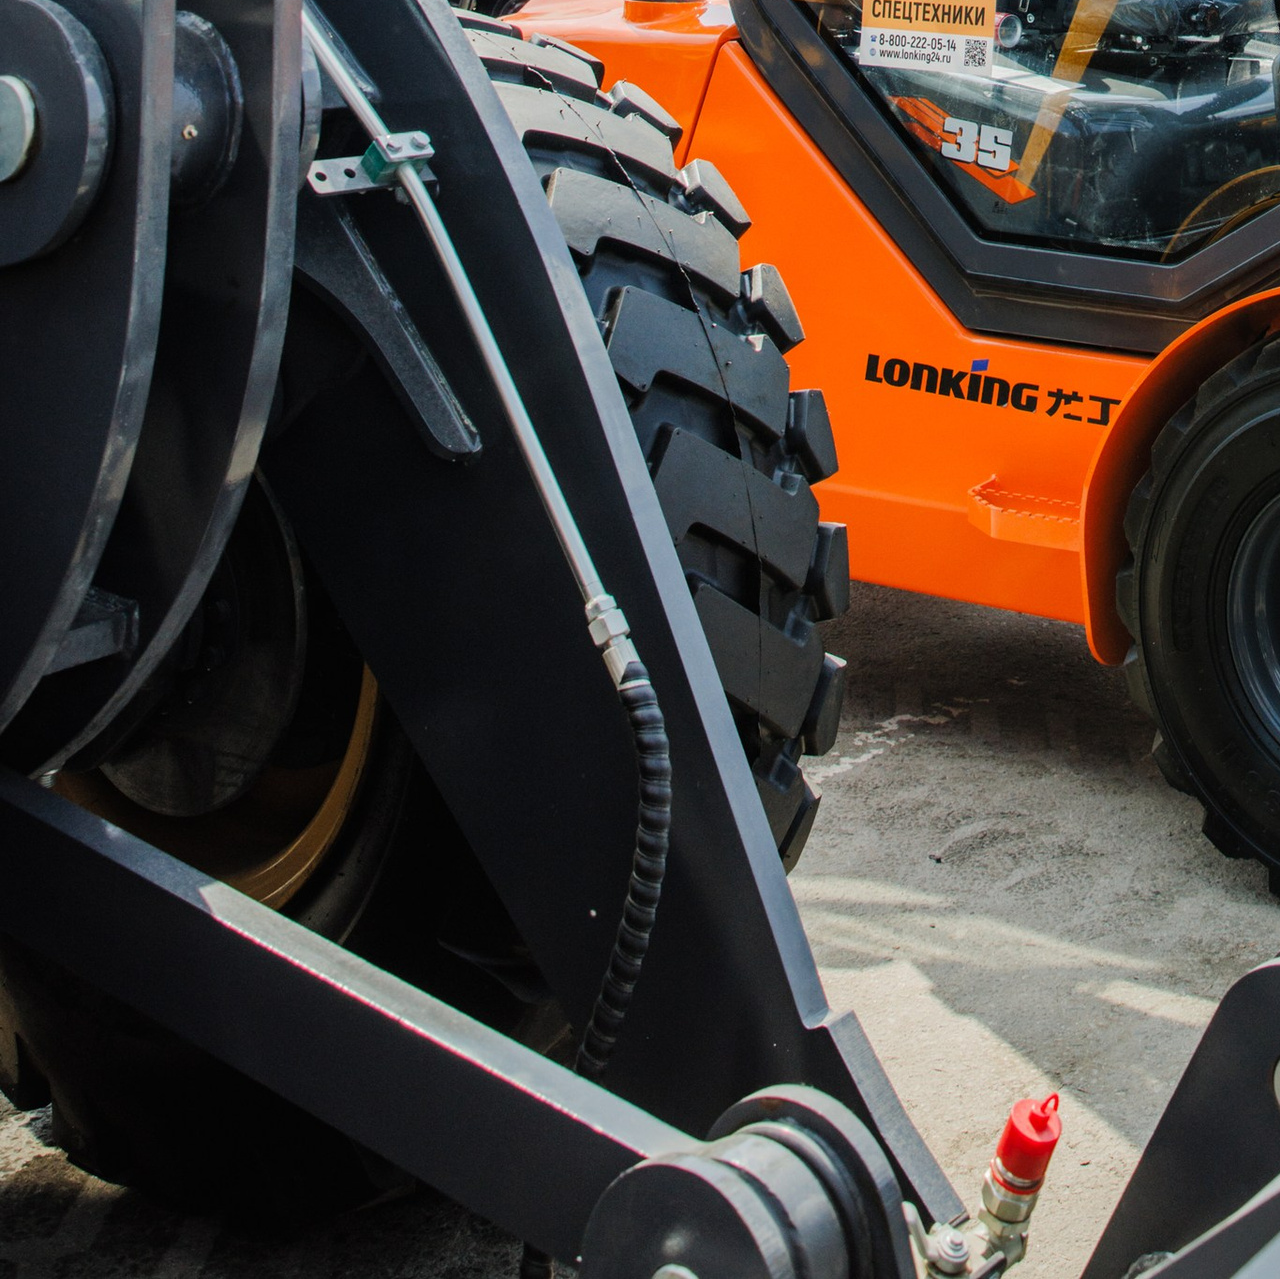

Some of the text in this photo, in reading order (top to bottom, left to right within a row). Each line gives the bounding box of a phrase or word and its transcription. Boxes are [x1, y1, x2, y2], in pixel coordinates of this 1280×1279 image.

[879, 33, 957, 52] 8-800-222-05-14
[879, 47, 952, 64] www.lonking24.ru
[941, 116, 1013, 172] 35
